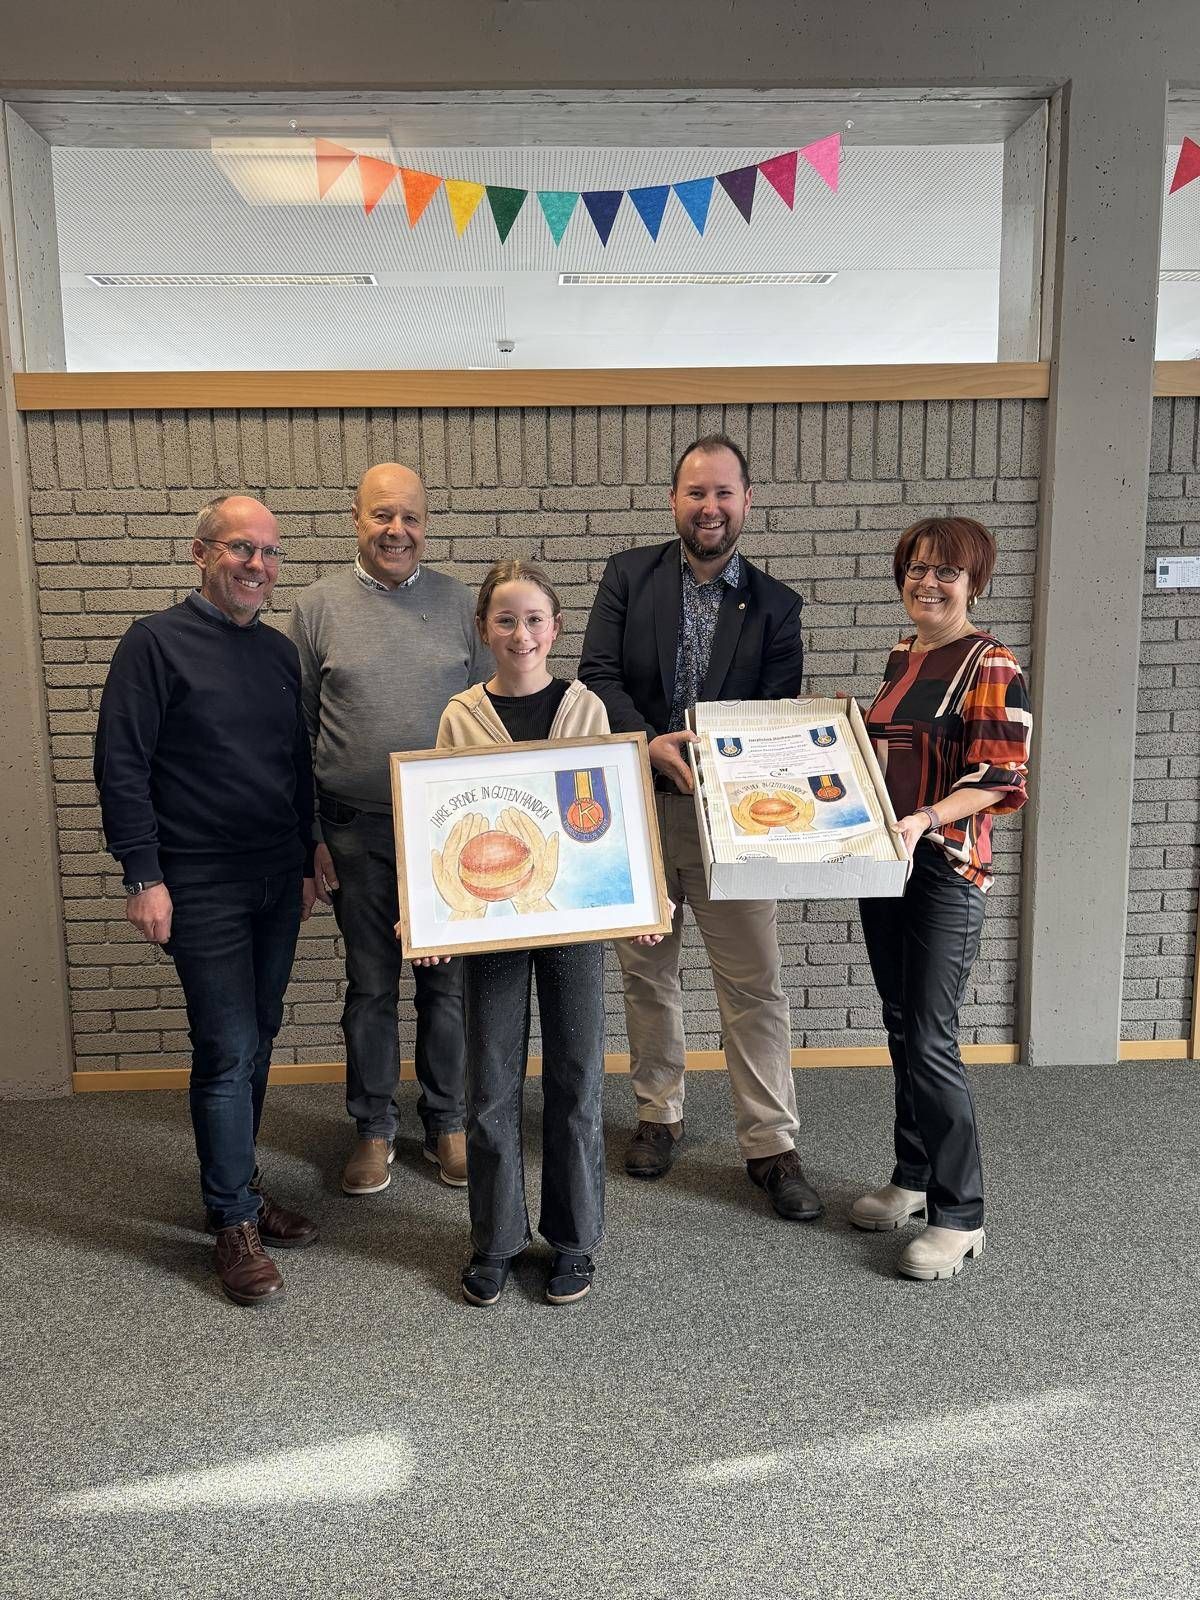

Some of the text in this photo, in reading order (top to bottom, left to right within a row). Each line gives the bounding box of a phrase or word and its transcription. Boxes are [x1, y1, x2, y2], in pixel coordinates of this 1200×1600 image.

[430, 804, 453, 829] IHRE
[449, 789, 478, 811] SPENDE
[481, 786, 490, 800] IN
[491, 785, 522, 804] GUTEN
[578, 802, 597, 829] K
